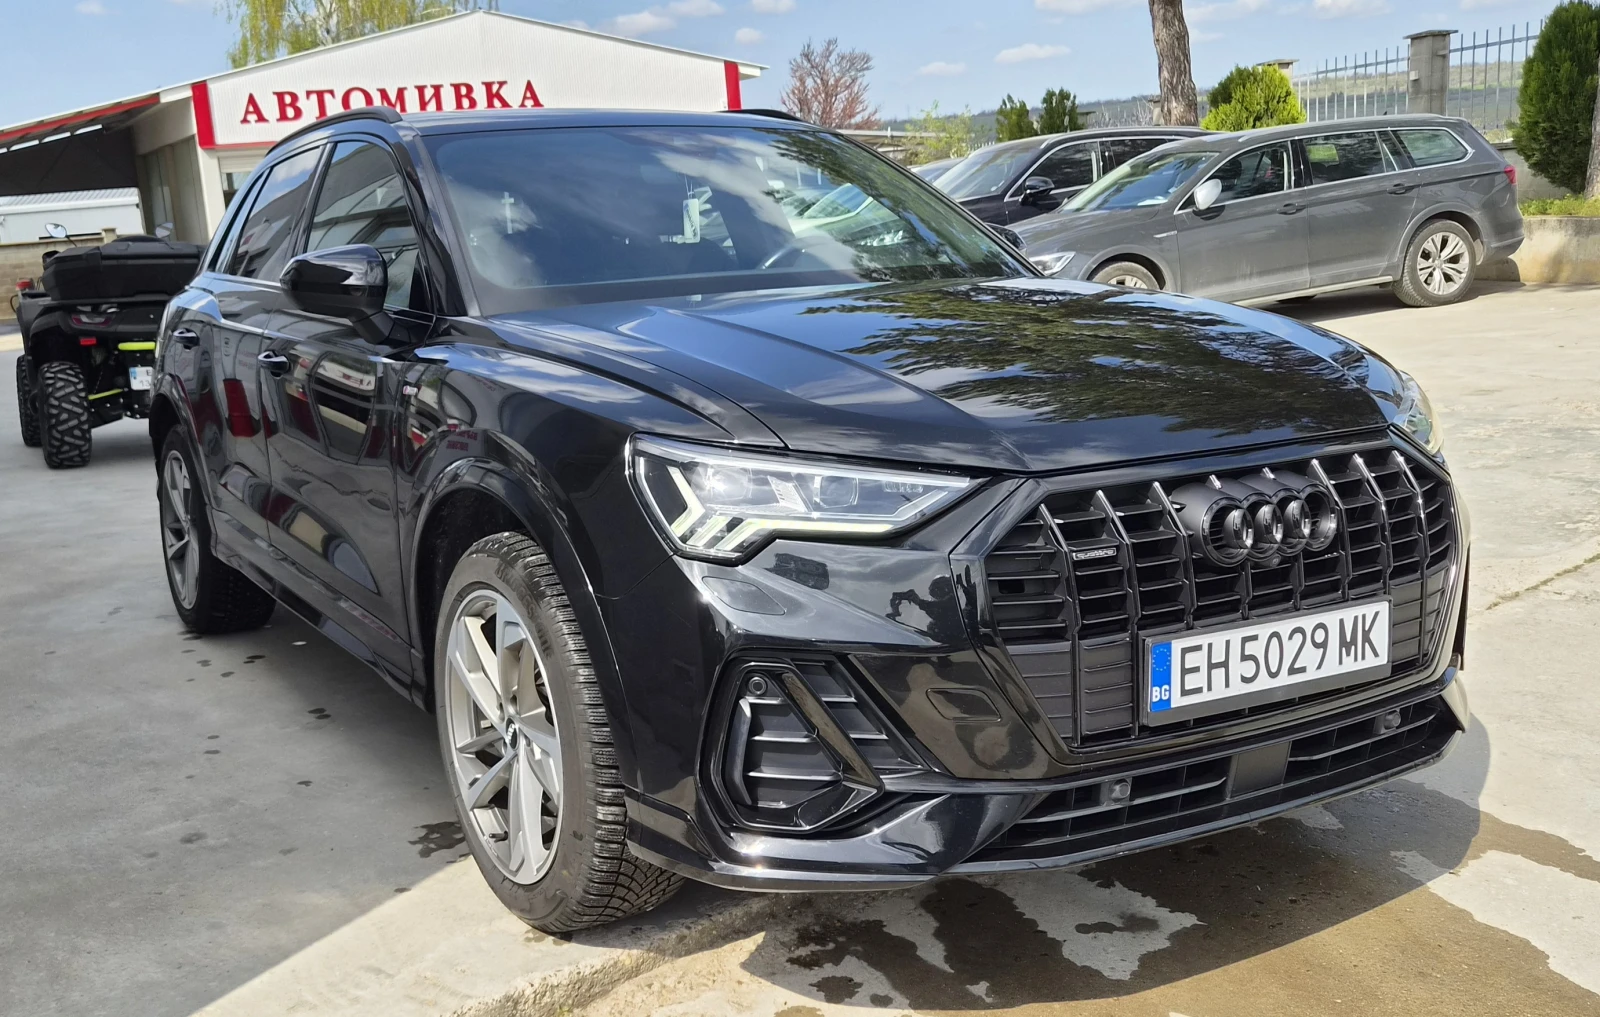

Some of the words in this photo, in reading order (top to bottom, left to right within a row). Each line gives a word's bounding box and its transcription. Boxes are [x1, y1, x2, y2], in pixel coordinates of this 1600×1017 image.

[240, 79, 544, 124] АВТОМИВКА
[1179, 639, 1231, 698] EH
[1239, 622, 1329, 684] 5029
[1338, 610, 1381, 666] MK
[1152, 684, 1170, 702] BG
